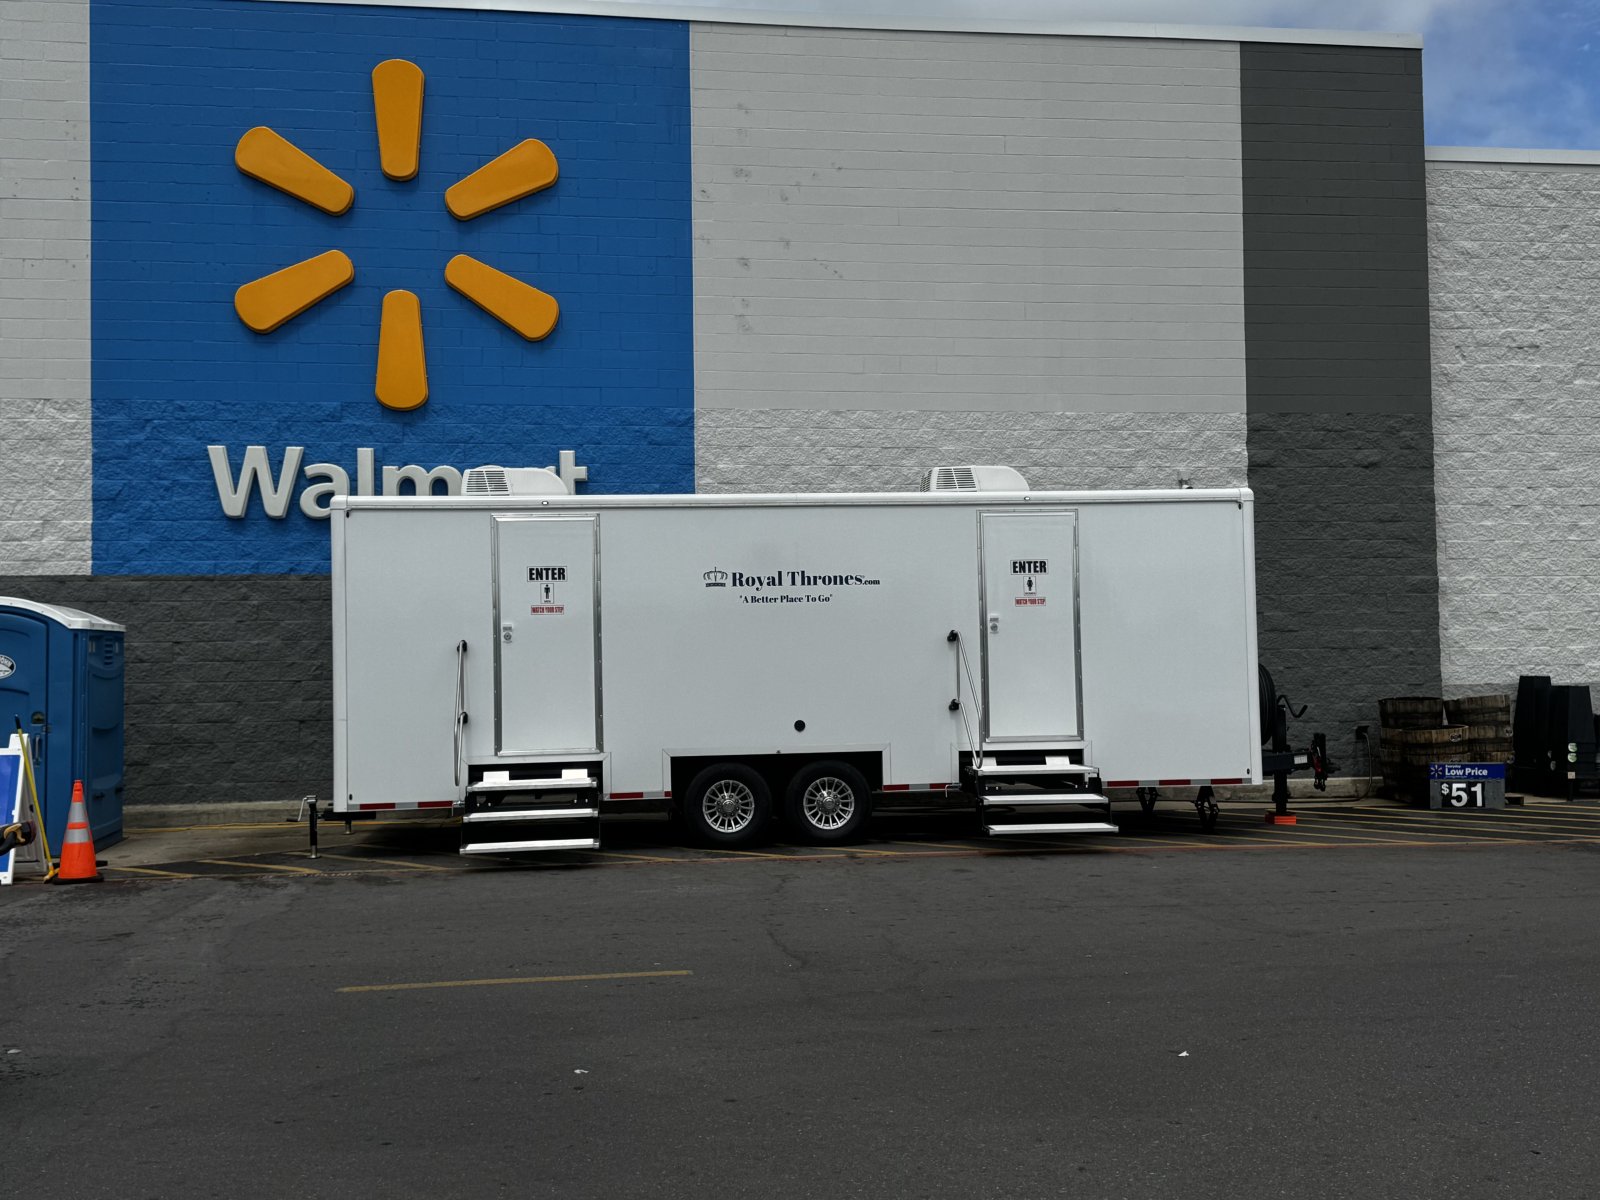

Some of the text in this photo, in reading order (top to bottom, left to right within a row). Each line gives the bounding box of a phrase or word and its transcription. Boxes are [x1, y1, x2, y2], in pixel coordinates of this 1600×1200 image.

[207, 445, 588, 519] Walmt
[528, 567, 566, 581] ENTER
[1012, 560, 1047, 574] ENTER
[731, 570, 784, 591] Royal
[750, 595, 779, 604] Better
[780, 594, 804, 603] Place
[804, 594, 817, 603] To
[1445, 767, 1488, 776] Low Price
[1441, 783, 1483, 807] $51
